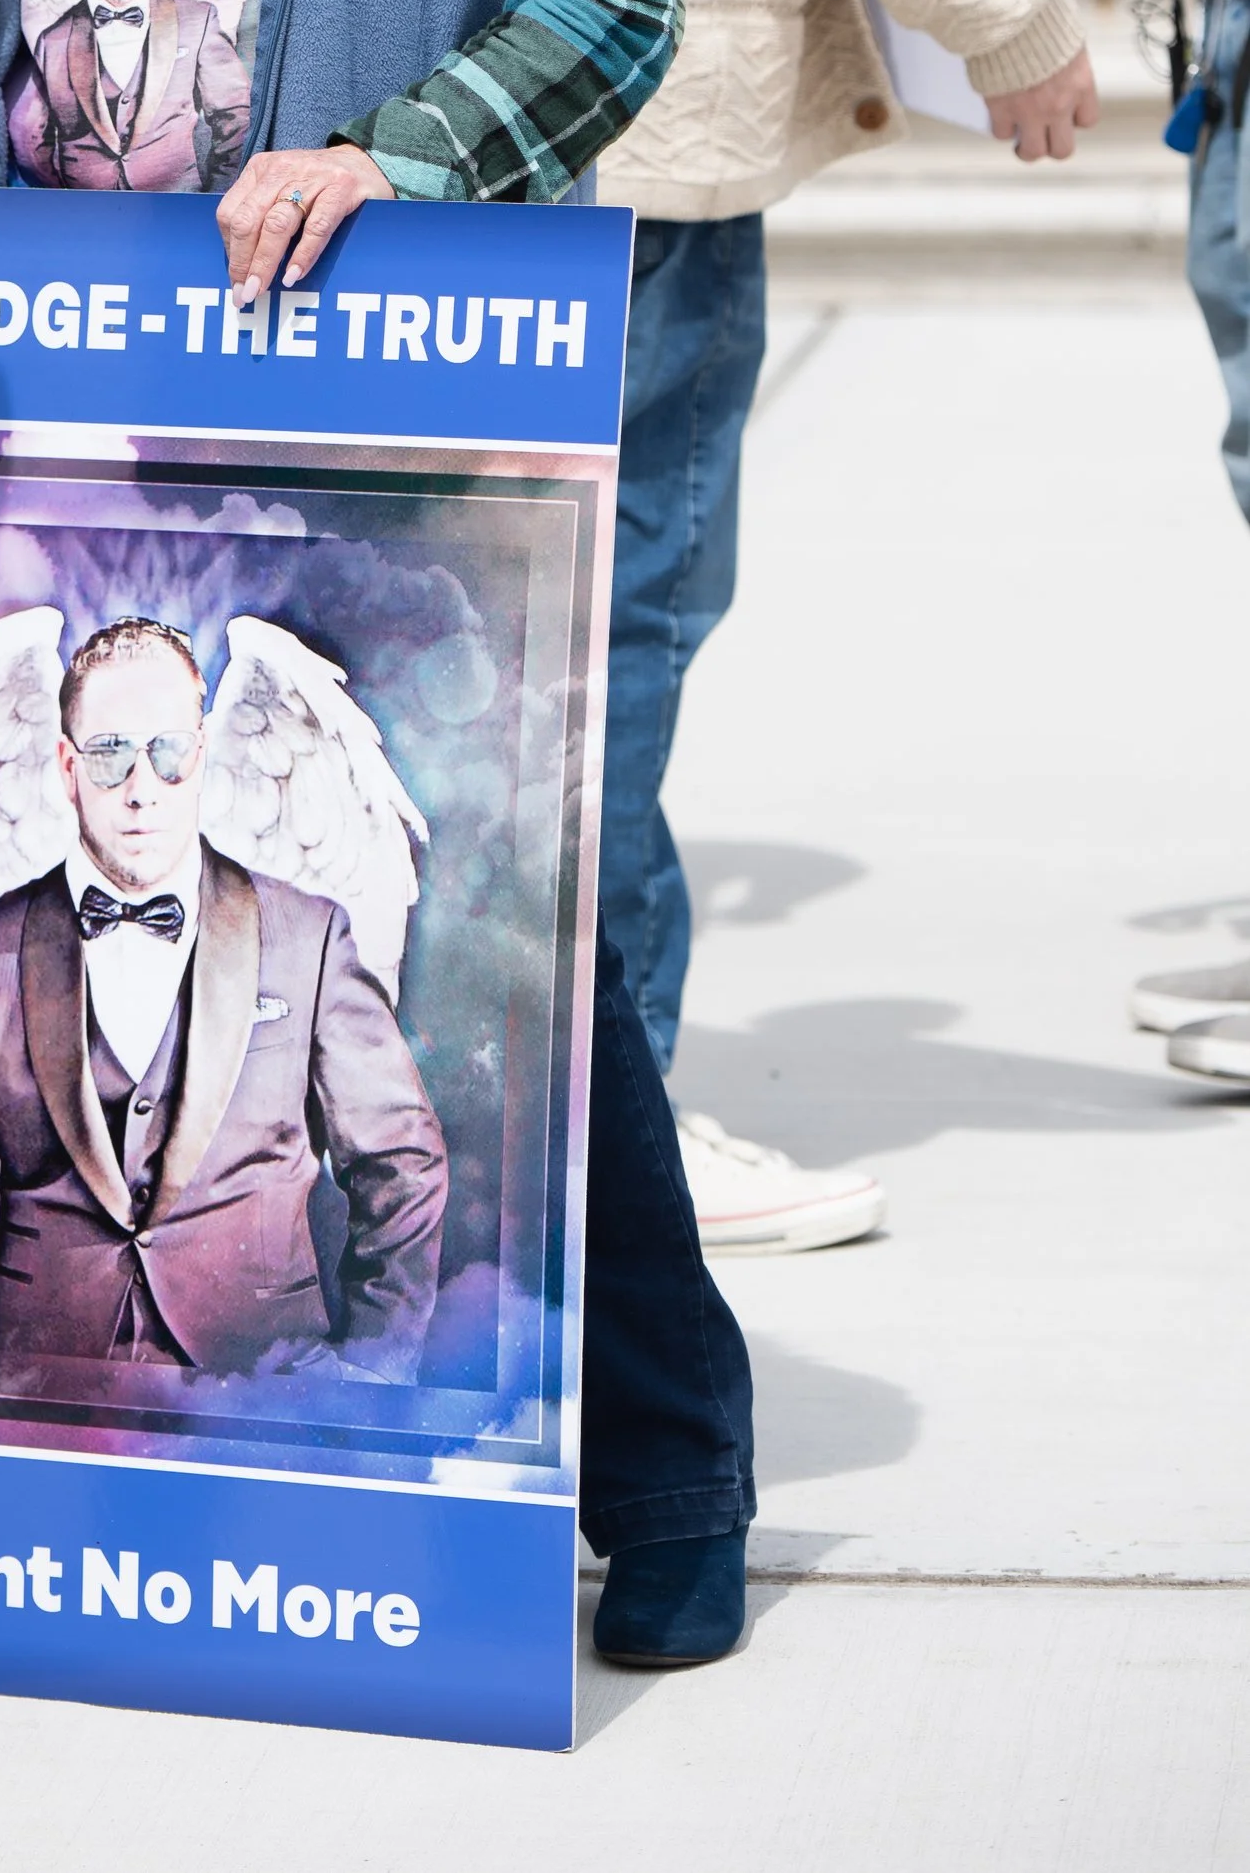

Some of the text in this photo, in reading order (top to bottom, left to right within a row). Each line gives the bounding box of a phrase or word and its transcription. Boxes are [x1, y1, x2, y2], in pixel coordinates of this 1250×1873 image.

[176, 287, 320, 358] THE
[337, 292, 587, 367] TRUTH
[82, 1547, 192, 1624] No
[212, 1560, 421, 1647] More
